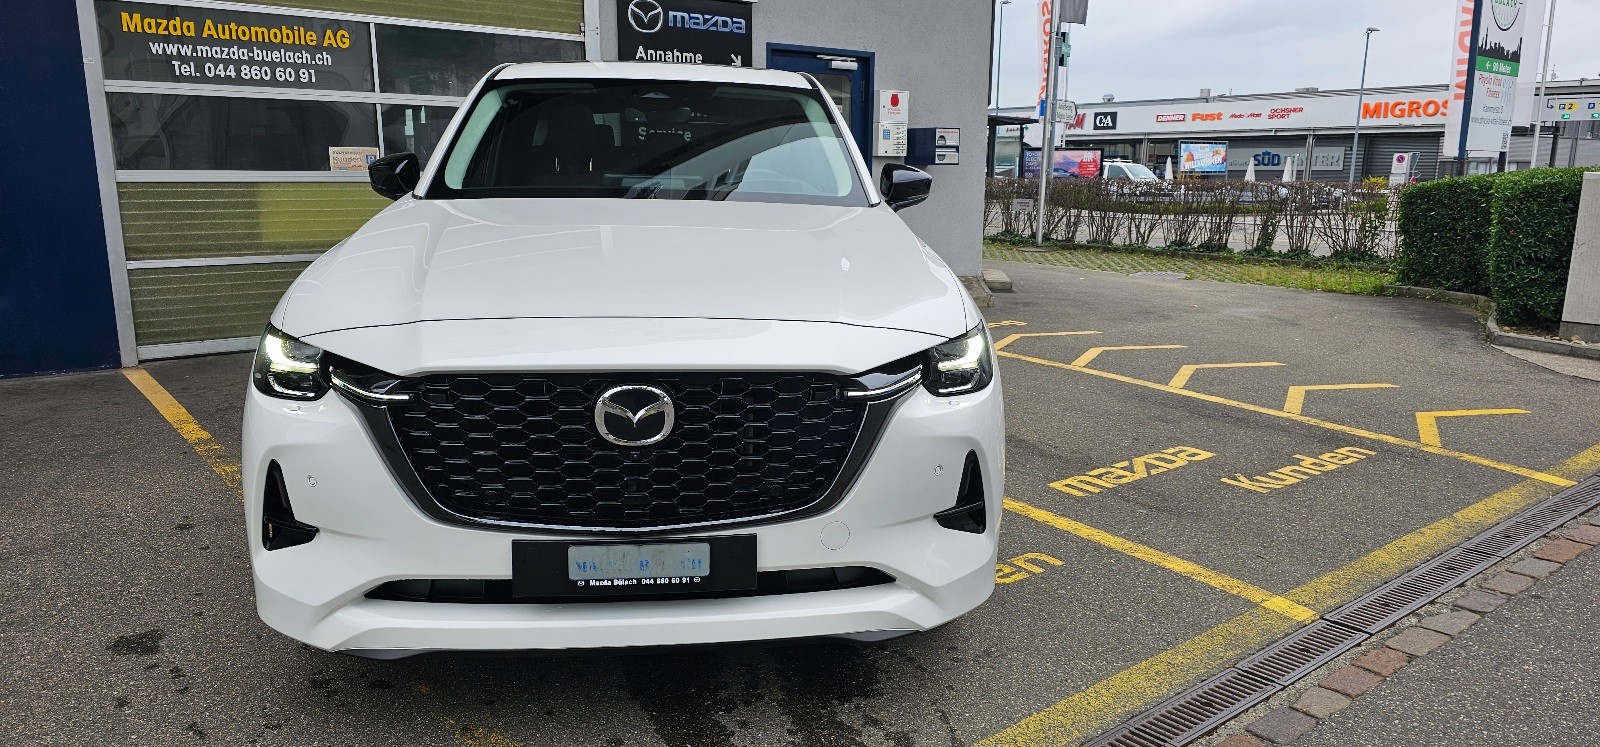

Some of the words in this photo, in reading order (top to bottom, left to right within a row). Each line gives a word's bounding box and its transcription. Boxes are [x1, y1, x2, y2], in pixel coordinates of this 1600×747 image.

[120, 11, 195, 37] Mazda
[202, 18, 317, 46] Automobile
[322, 29, 351, 49] AG
[148, 40, 332, 66] www.mazda-buelach.ch
[635, 45, 703, 64] Annahme
[172, 60, 200, 77] Tel.
[204, 62, 236, 79] 044
[241, 65, 271, 81] 860
[275, 66, 295, 82] 60
[299, 68, 316, 83] 91
[1499, 62, 1512, 74] Meter
[1096, 115, 1113, 127] C&A
[1191, 112, 1223, 122] Fust
[1253, 150, 1281, 166] SÜD
[1220, 445, 1376, 494] Kunden
